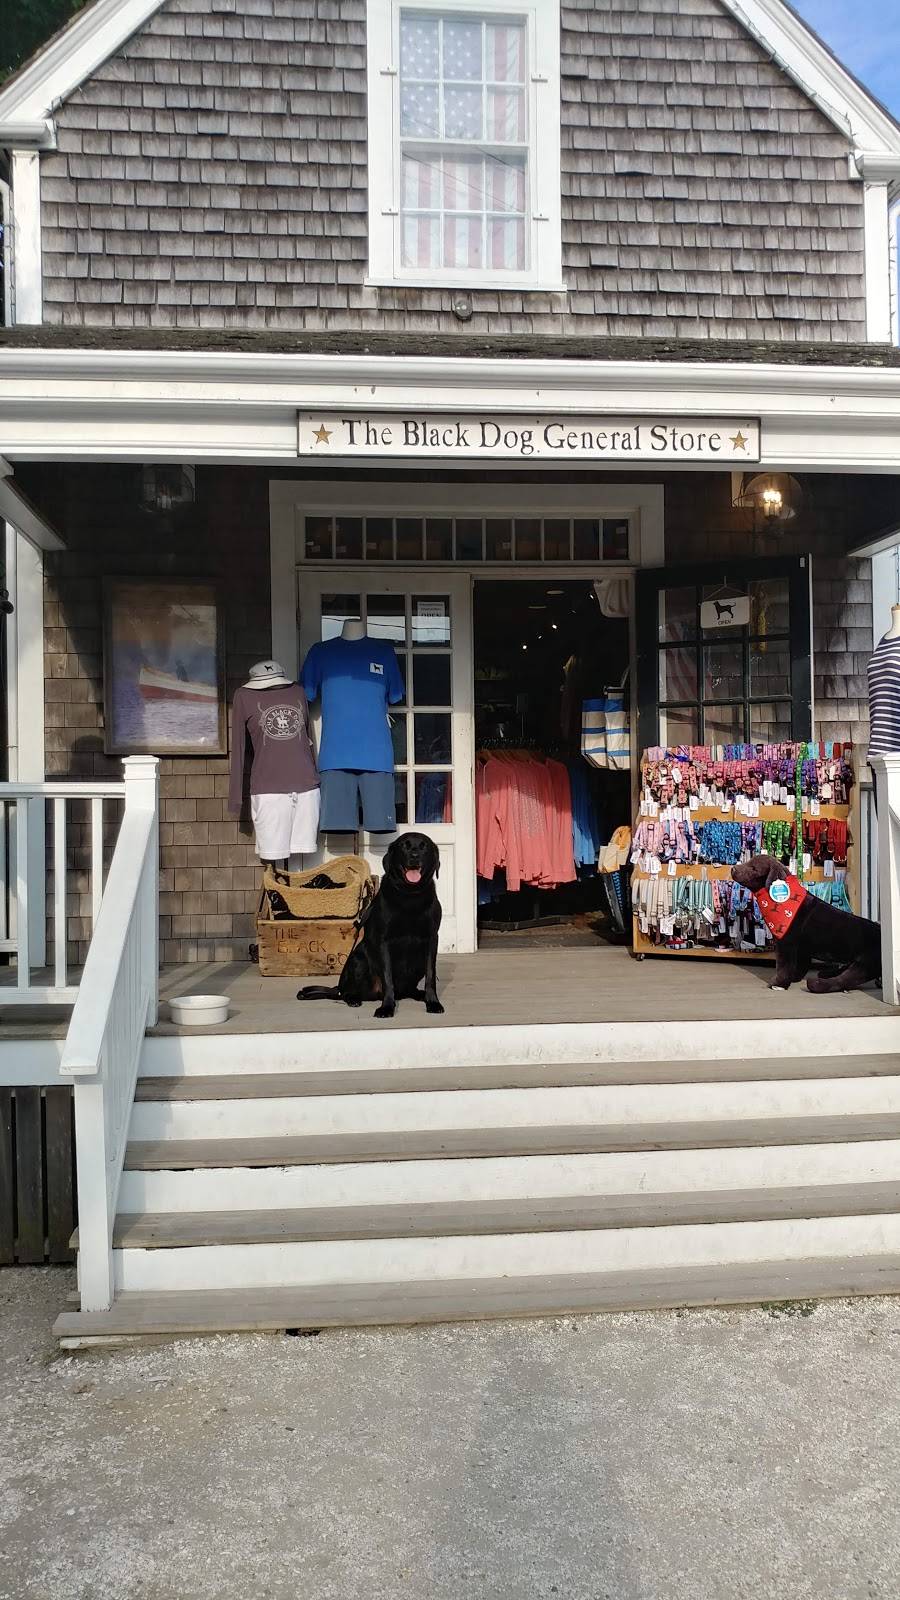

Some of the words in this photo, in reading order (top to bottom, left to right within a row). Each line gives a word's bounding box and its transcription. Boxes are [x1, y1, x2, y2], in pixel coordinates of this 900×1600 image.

[342, 419, 393, 446] The
[402, 420, 471, 448] Black
[479, 422, 534, 455] Dog
[543, 423, 642, 451] General
[650, 425, 722, 451] Store
[271, 709, 293, 718] BLACK
[273, 927, 300, 940] THE
[327, 953, 349, 966] DO
